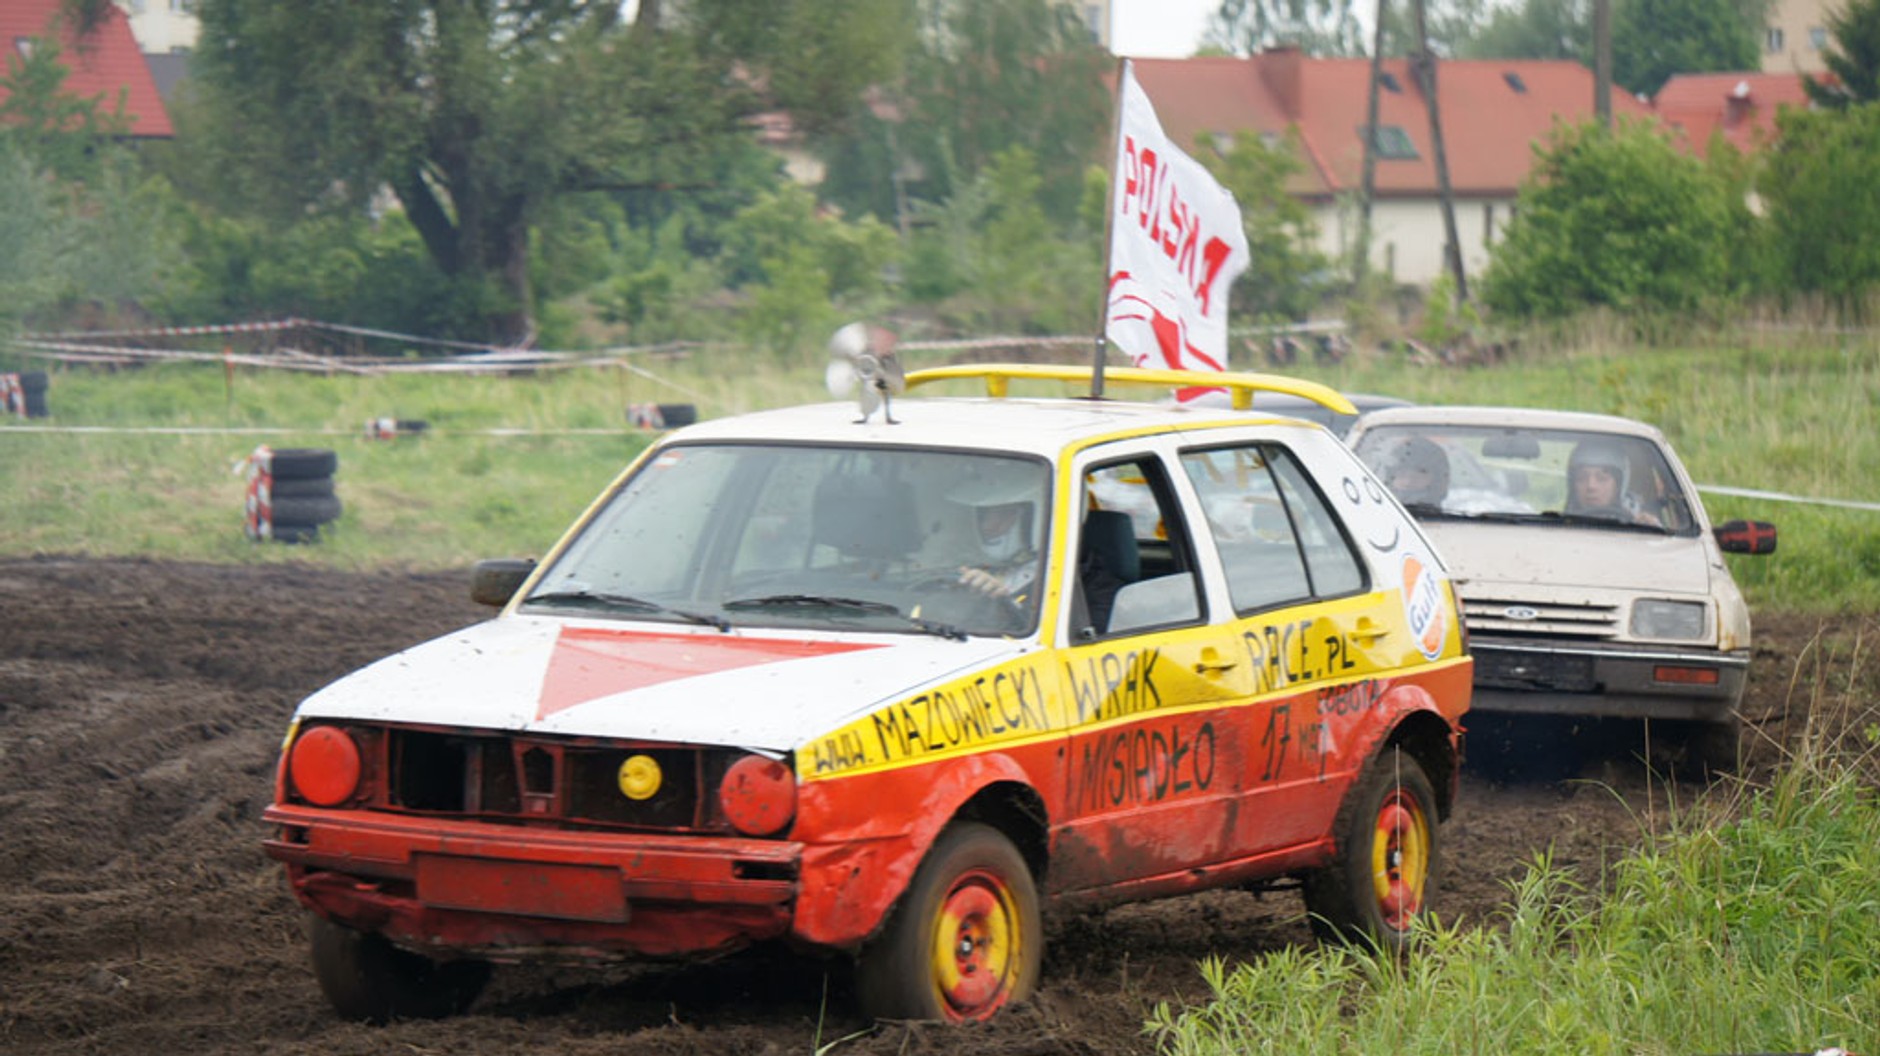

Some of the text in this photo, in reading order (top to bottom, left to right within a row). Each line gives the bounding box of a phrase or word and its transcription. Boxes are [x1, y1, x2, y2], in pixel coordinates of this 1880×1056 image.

[1122, 133, 1233, 318] POLSKA
[1409, 571, 1439, 636] Gulf
[1064, 646, 1162, 724] WRAK
[1260, 702, 1291, 782] 17
